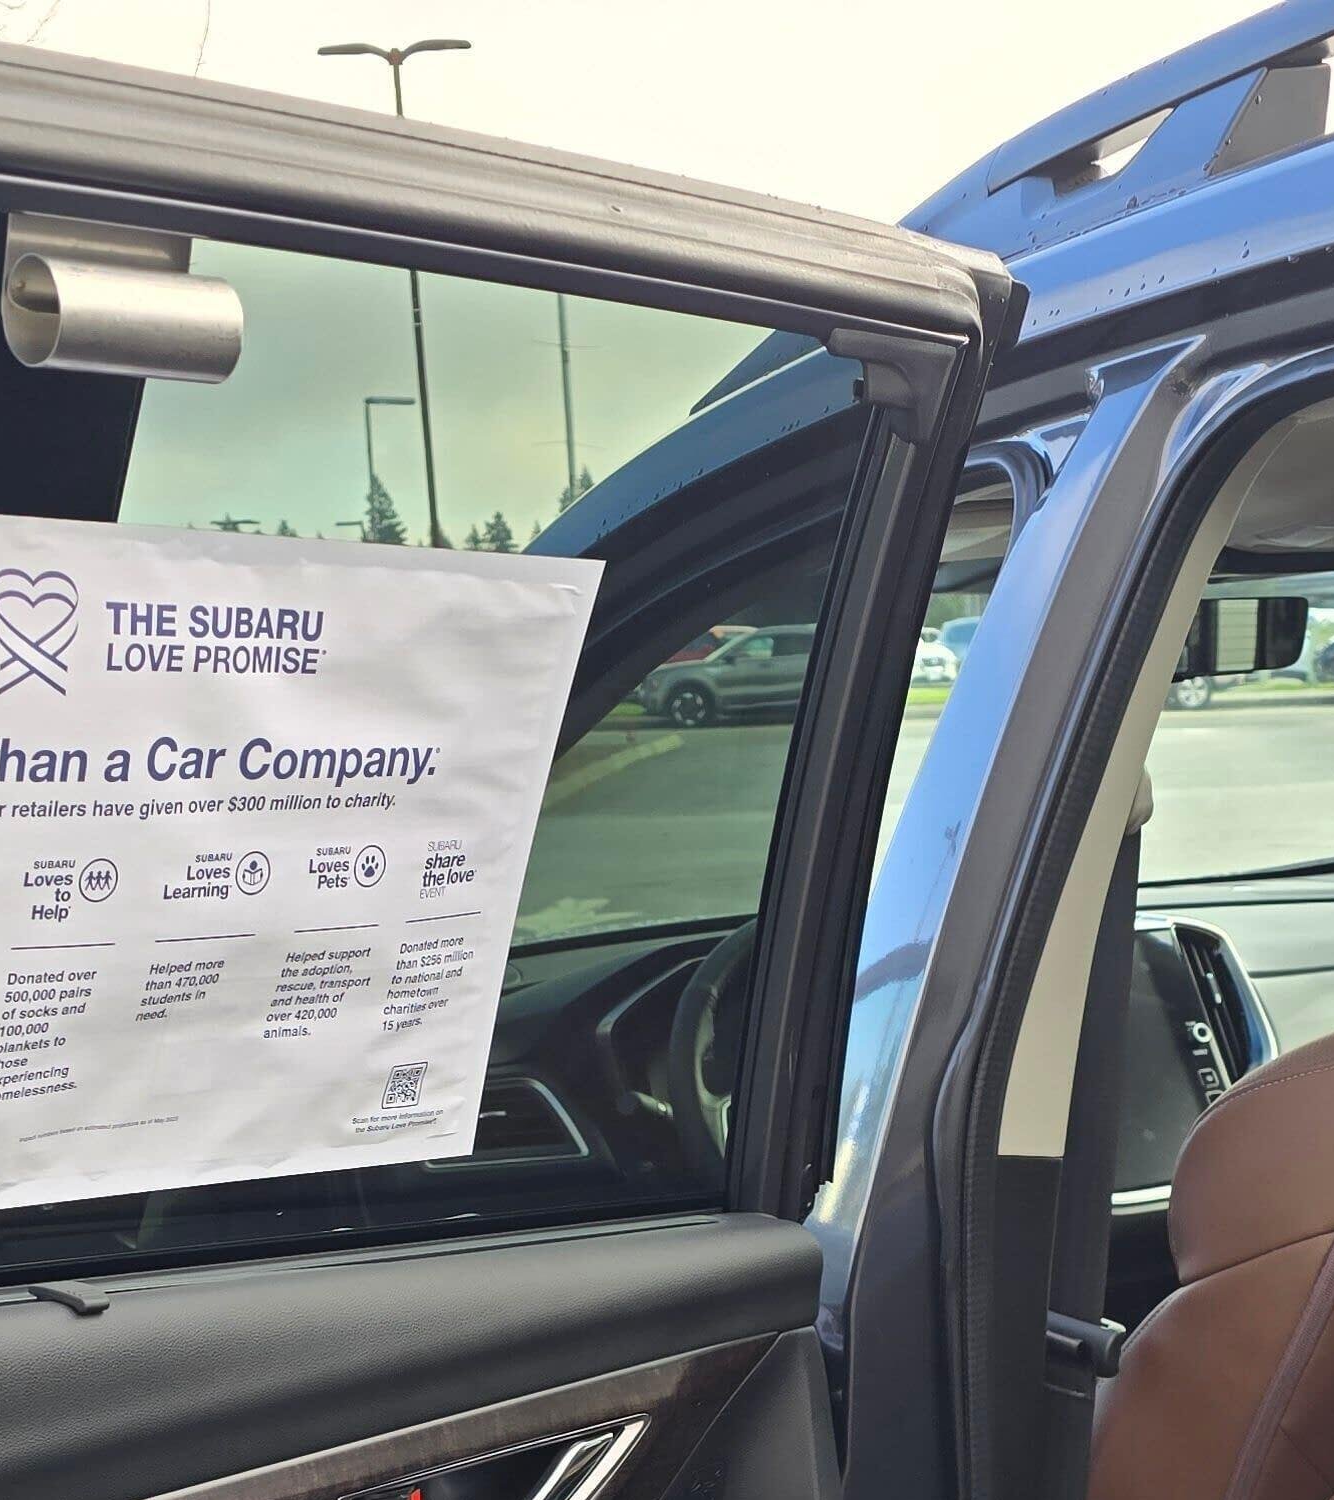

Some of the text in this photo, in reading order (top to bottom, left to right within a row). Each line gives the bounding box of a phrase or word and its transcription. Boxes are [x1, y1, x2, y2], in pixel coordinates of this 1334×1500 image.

[106, 601, 324, 642] THE SUBARU
[106, 642, 320, 674] LOVE PROMISE
[104, 749, 131, 783] a
[147, 736, 227, 782] Car
[239, 737, 436, 788] Company.
[11, 800, 87, 818] retailers
[92, 799, 138, 818] have
[139, 799, 183, 820] given
[188, 799, 225, 814] over
[227, 795, 266, 814] $300
[269, 794, 319, 810] million
[326, 794, 341, 809] to
[344, 792, 396, 811] charity.
[316, 846, 352, 857] SUBARU
[427, 840, 462, 853] SUBARU
[33, 859, 76, 870] SUBARU
[195, 852, 233, 863] SUBARU
[424, 852, 466, 870] share
[186, 865, 231, 881] Loves
[309, 858, 350, 874] Loves
[23, 871, 74, 887] Loves
[317, 874, 348, 890] Pets
[422, 867, 475, 888] the love
[54, 888, 71, 903] to
[163, 883, 229, 901] Learning
[419, 886, 446, 899] EVENT
[31, 904, 69, 923] Help
[400, 937, 464, 954] Donated more
[285, 947, 371, 964] Helped support
[396, 949, 474, 971] than $256 million
[149, 960, 225, 976] Helped more
[281, 962, 353, 978] the adoption,
[7, 970, 97, 986] Donated over
[144, 973, 220, 992] than 470,000
[275, 977, 371, 993] rescue, transport
[391, 966, 463, 988] to national and
[4, 986, 92, 1004] 500,000 pairs
[140, 989, 206, 1007] students in
[270, 991, 346, 1007] and health of
[386, 984, 439, 1001] hometown
[1, 1002, 87, 1021] of socks and
[266, 1007, 338, 1022] over 420,000
[383, 997, 449, 1016] charities over
[135, 1008, 168, 1022] need.
[0, 1022, 49, 1038] 100,000
[263, 1025, 311, 1039] animals.
[382, 1017, 423, 1032] 15 years.
[53, 1036, 66, 1047] to
[399, 1111, 434, 1119] information
